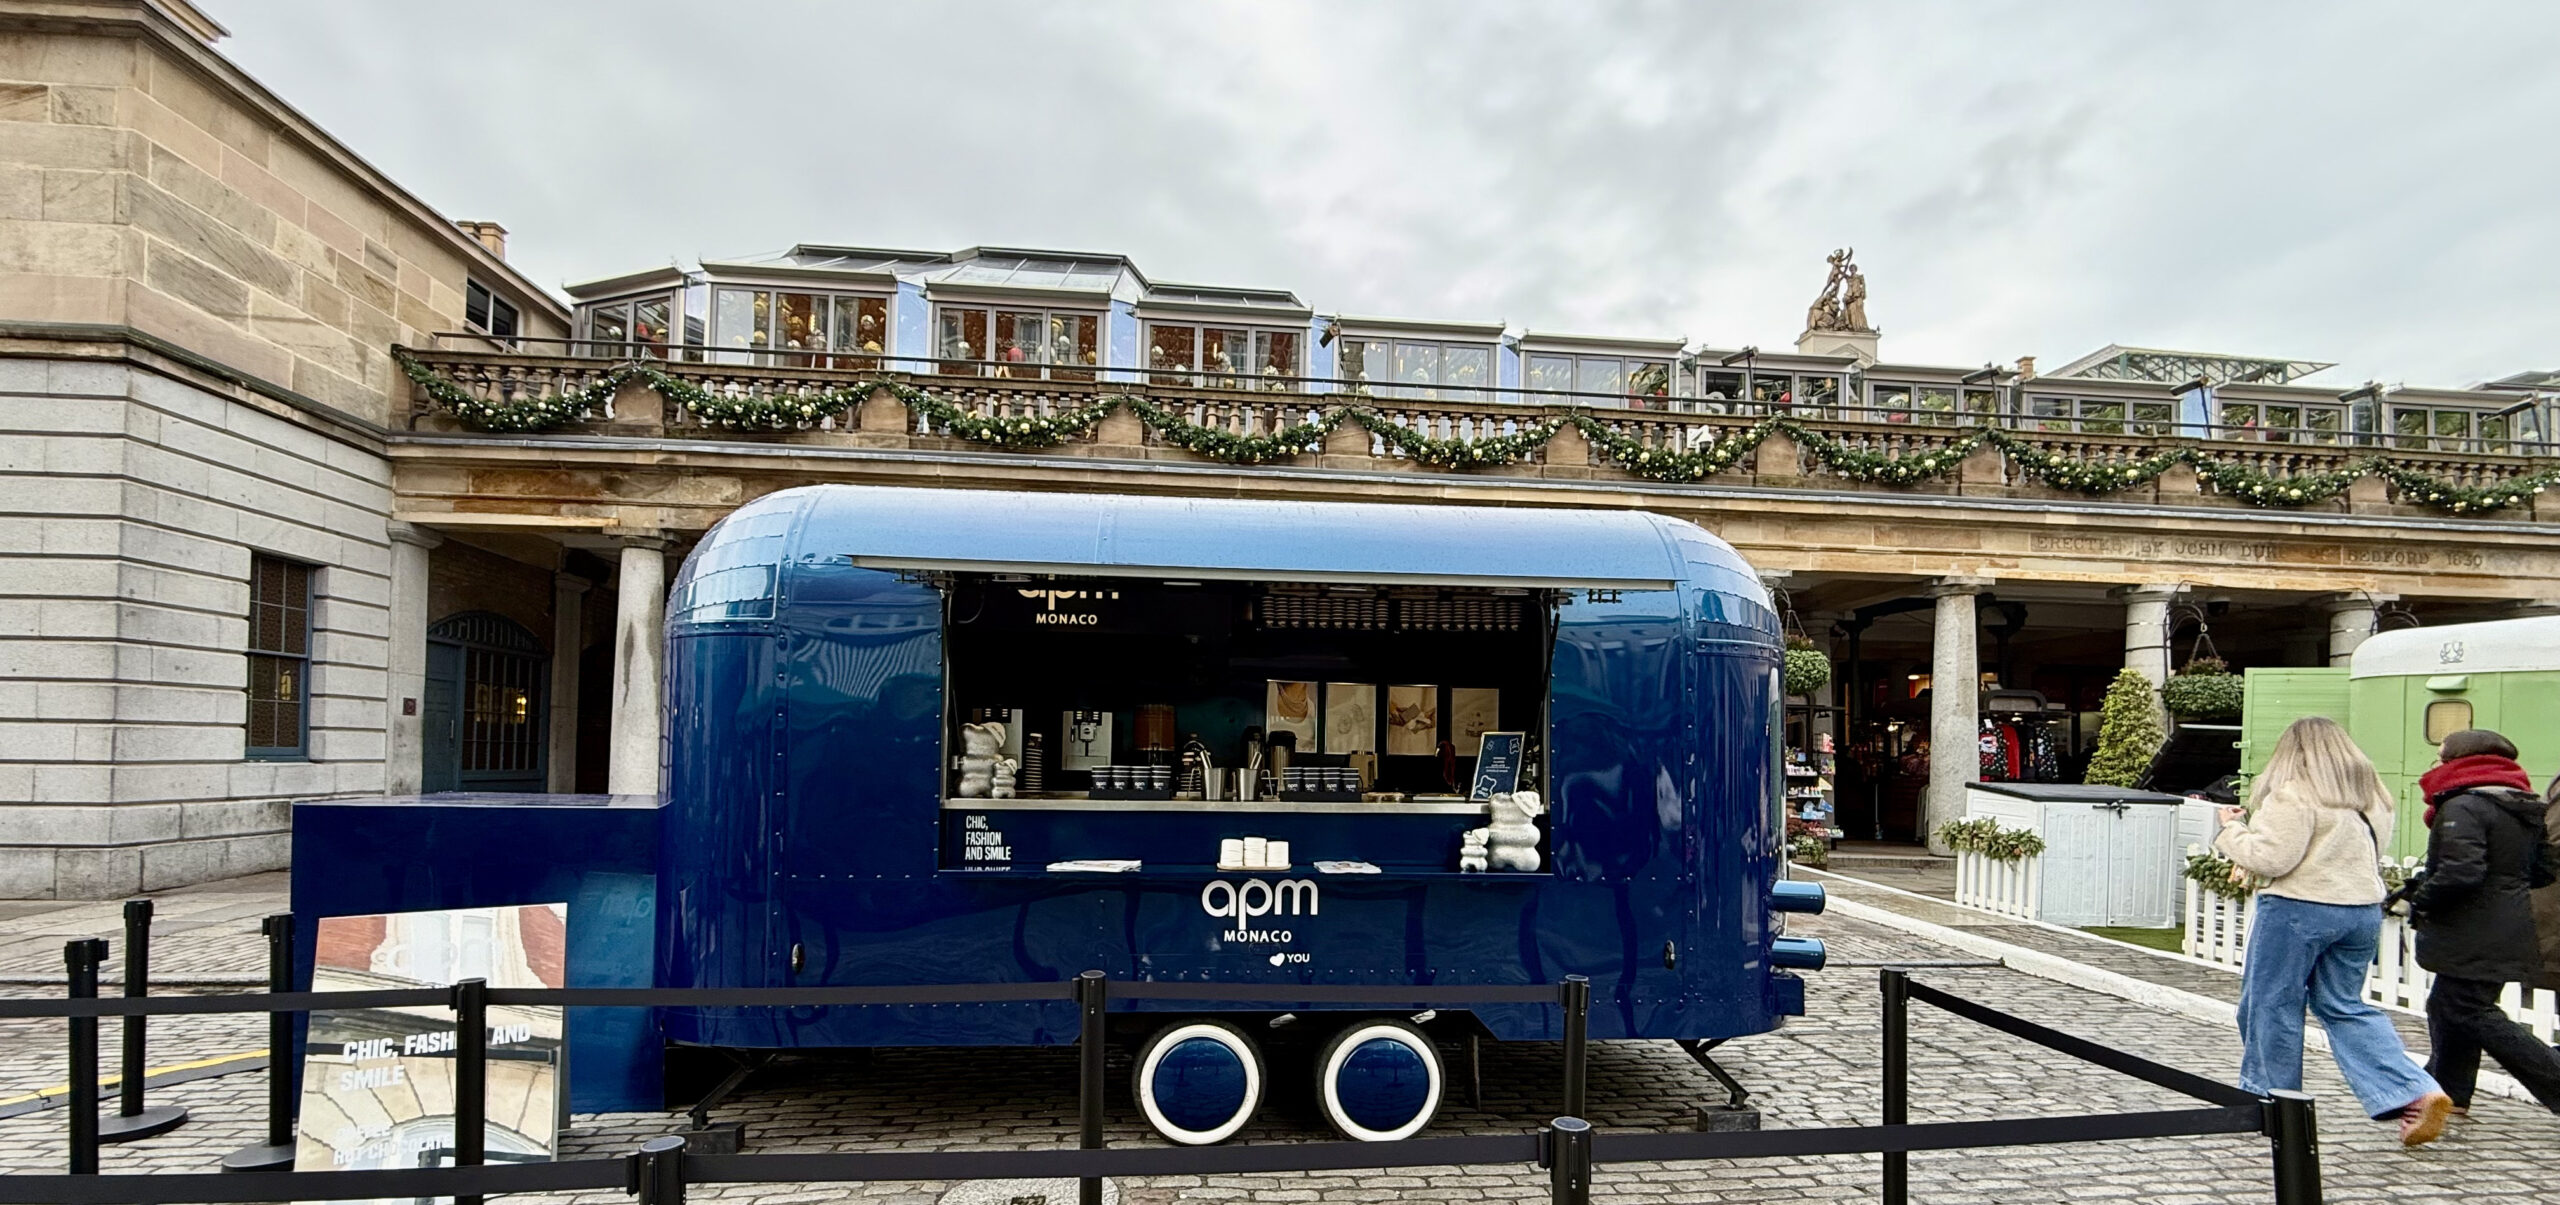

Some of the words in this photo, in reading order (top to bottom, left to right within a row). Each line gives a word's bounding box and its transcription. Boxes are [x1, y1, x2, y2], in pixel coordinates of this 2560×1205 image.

[1036, 613, 1098, 625] MONACO
[966, 815, 989, 831] CHIC,
[966, 831, 1002, 846] FASHION
[965, 846, 983, 860] AND
[984, 846, 1012, 860] SMILE
[1202, 878, 1319, 931] apm
[1223, 930, 1292, 943] MONACO
[1286, 953, 1311, 963] YOU
[342, 1037, 399, 1063] CHIC,
[404, 1030, 458, 1056] FASH
[491, 1023, 531, 1045] AND
[340, 1065, 405, 1091] SMILE
